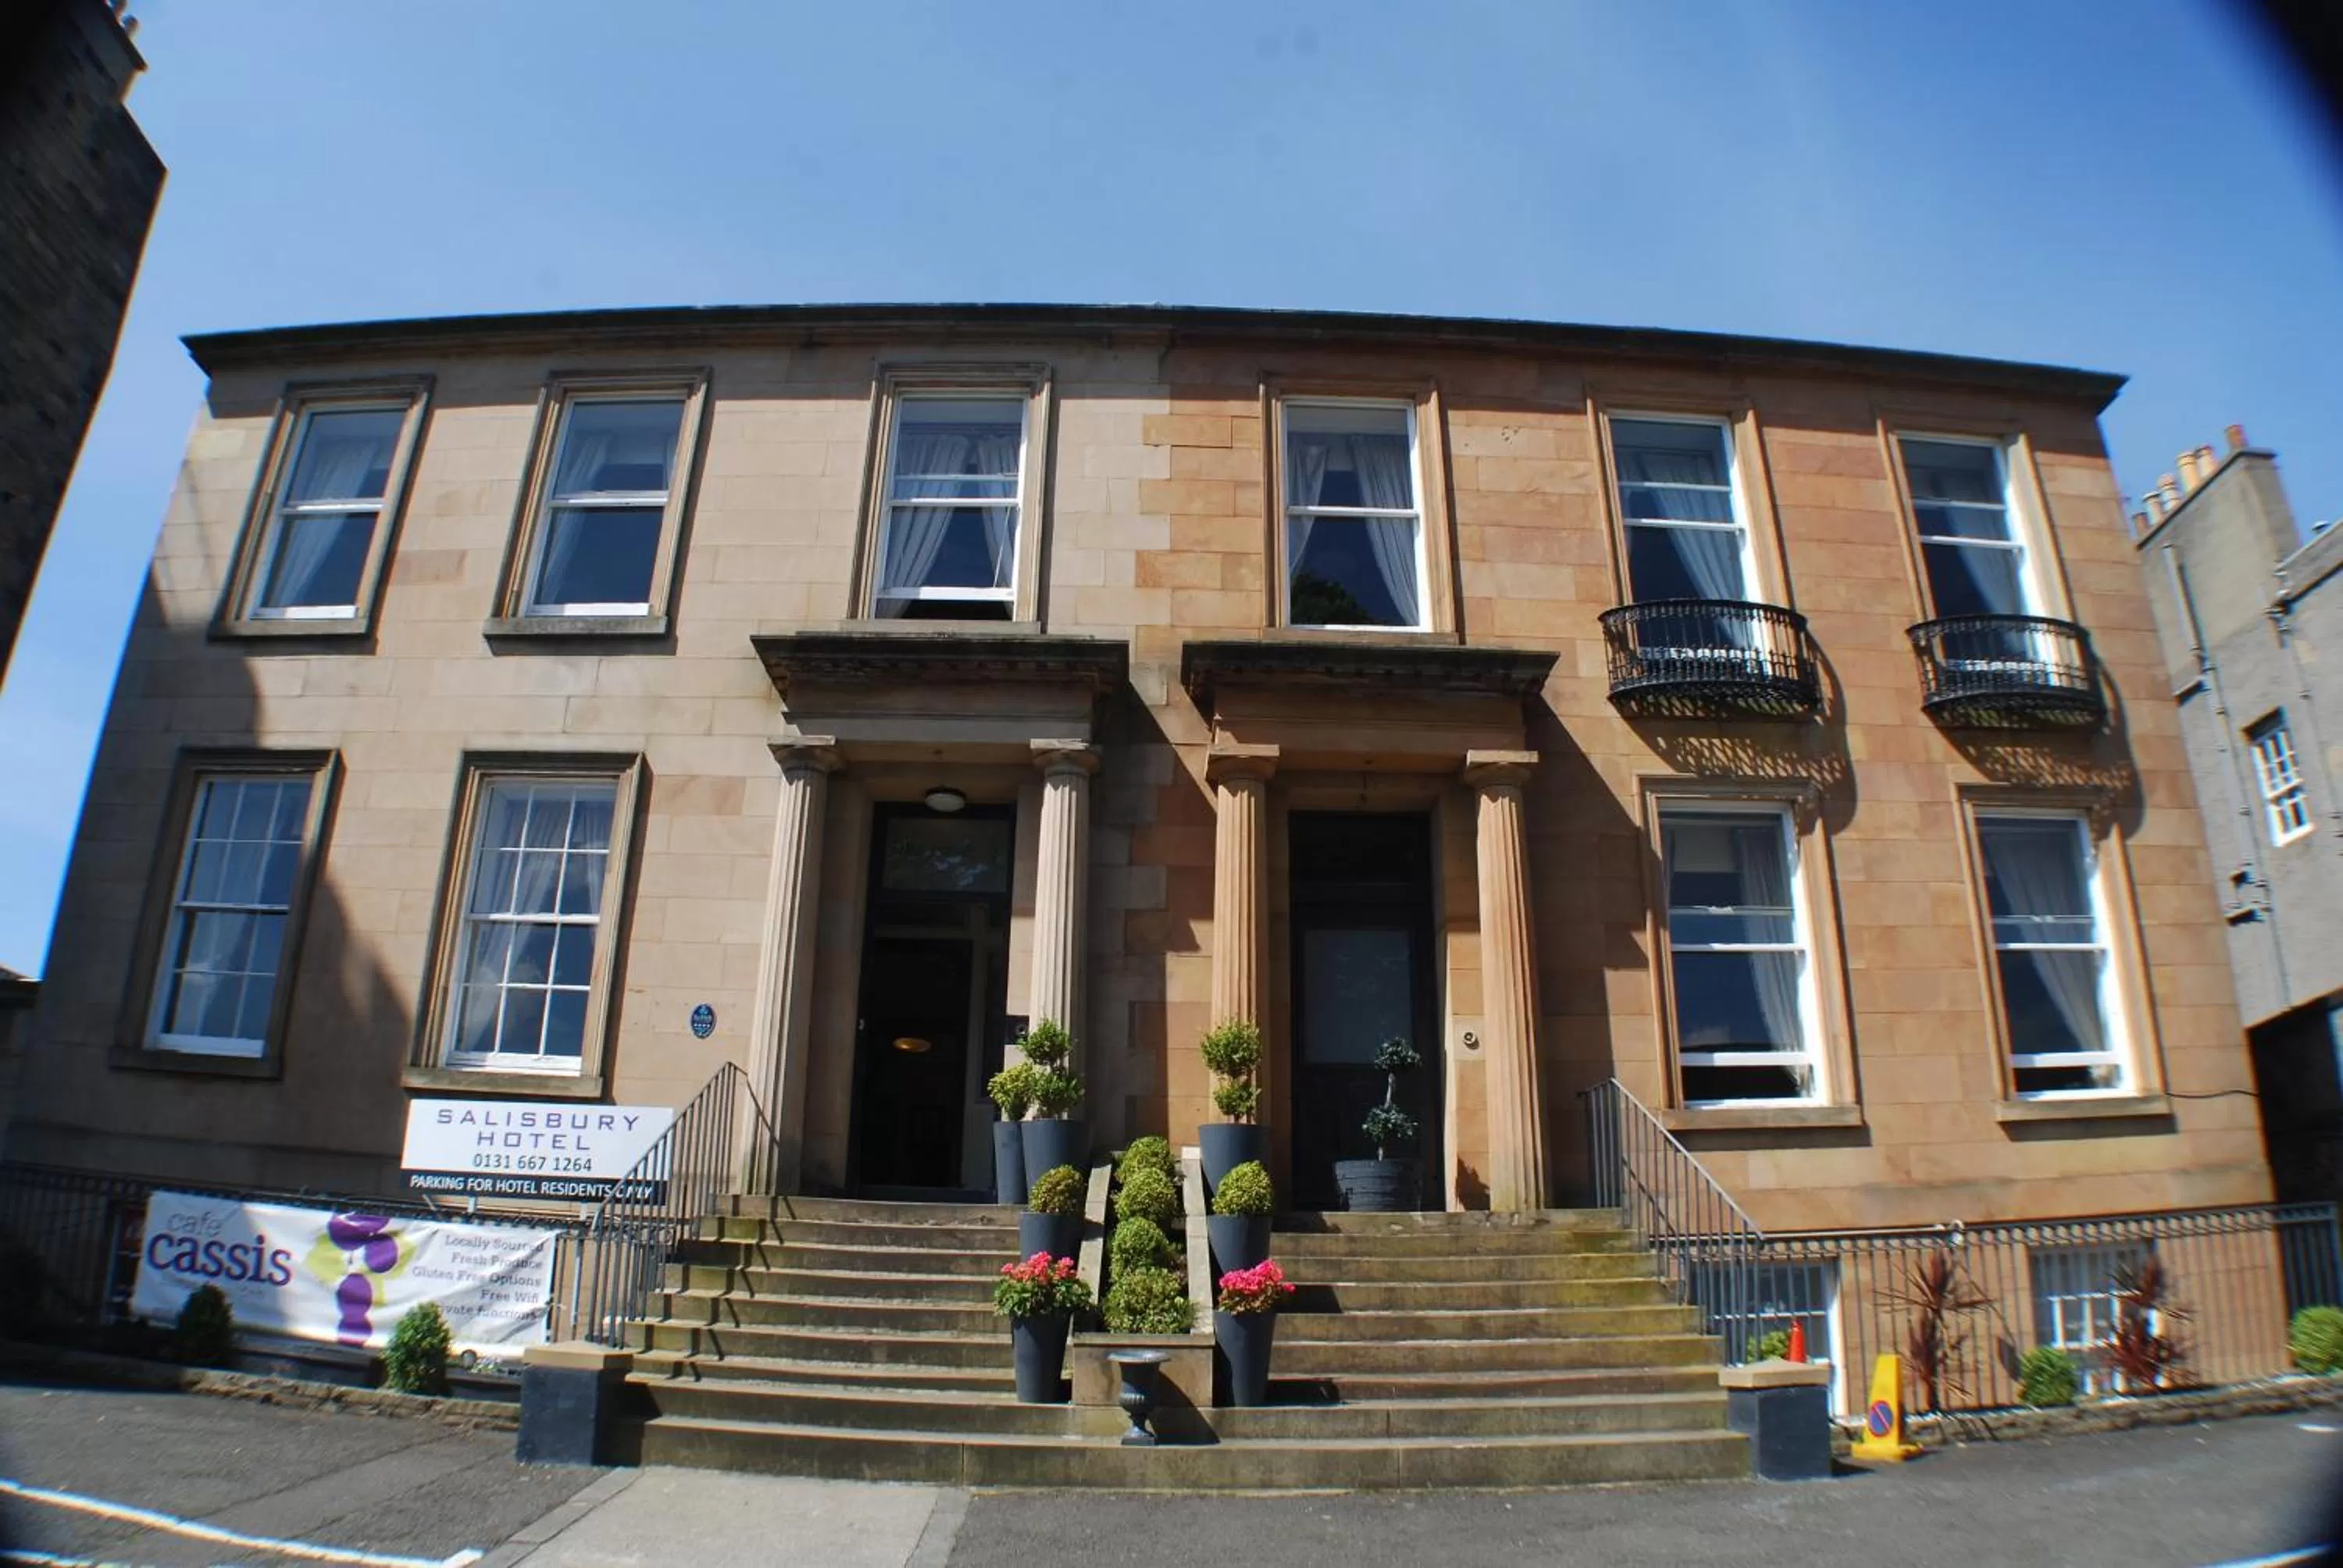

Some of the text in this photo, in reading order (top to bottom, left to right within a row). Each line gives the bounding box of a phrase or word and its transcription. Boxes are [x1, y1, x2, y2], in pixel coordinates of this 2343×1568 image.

[437, 1109, 640, 1131] SALISBURY
[477, 1131, 590, 1150] HOTEL
[473, 1153, 592, 1171] 0131 667 1264
[409, 1174, 465, 1189] PARKING
[466, 1177, 492, 1192] FOR
[495, 1178, 537, 1194] HOTEL
[540, 1181, 613, 1197] RESIDENTS
[445, 1235, 544, 1252] Locally Sourd
[148, 1233, 293, 1286] cassis
[451, 1252, 487, 1267] Fresh
[412, 1266, 454, 1281] Gluten
[456, 1270, 485, 1282] Fr
[480, 1289, 510, 1301] Free
